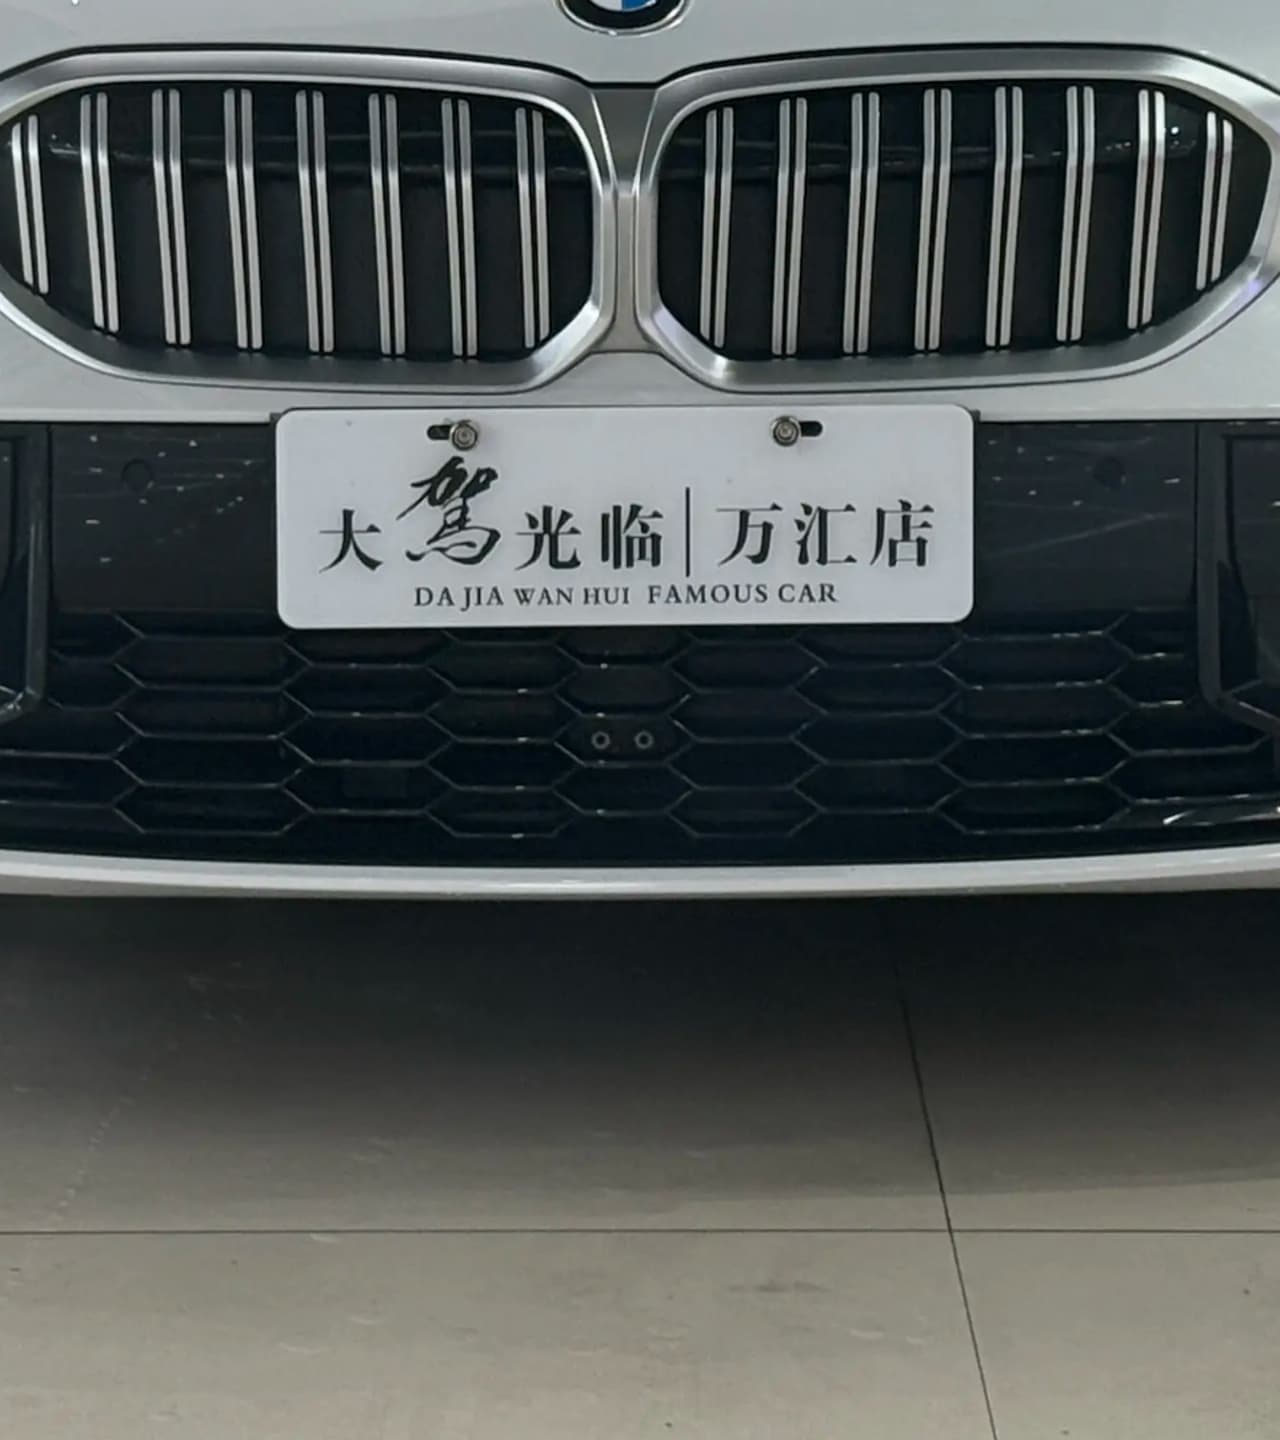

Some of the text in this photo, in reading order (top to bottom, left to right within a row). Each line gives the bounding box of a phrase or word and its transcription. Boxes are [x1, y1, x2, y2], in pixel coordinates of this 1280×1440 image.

[715, 499, 936, 569] 万汇店
[513, 587, 574, 606] WAN
[582, 587, 630, 606] HUI
[647, 583, 769, 606] FAMOUS
[777, 582, 838, 604] CAR
